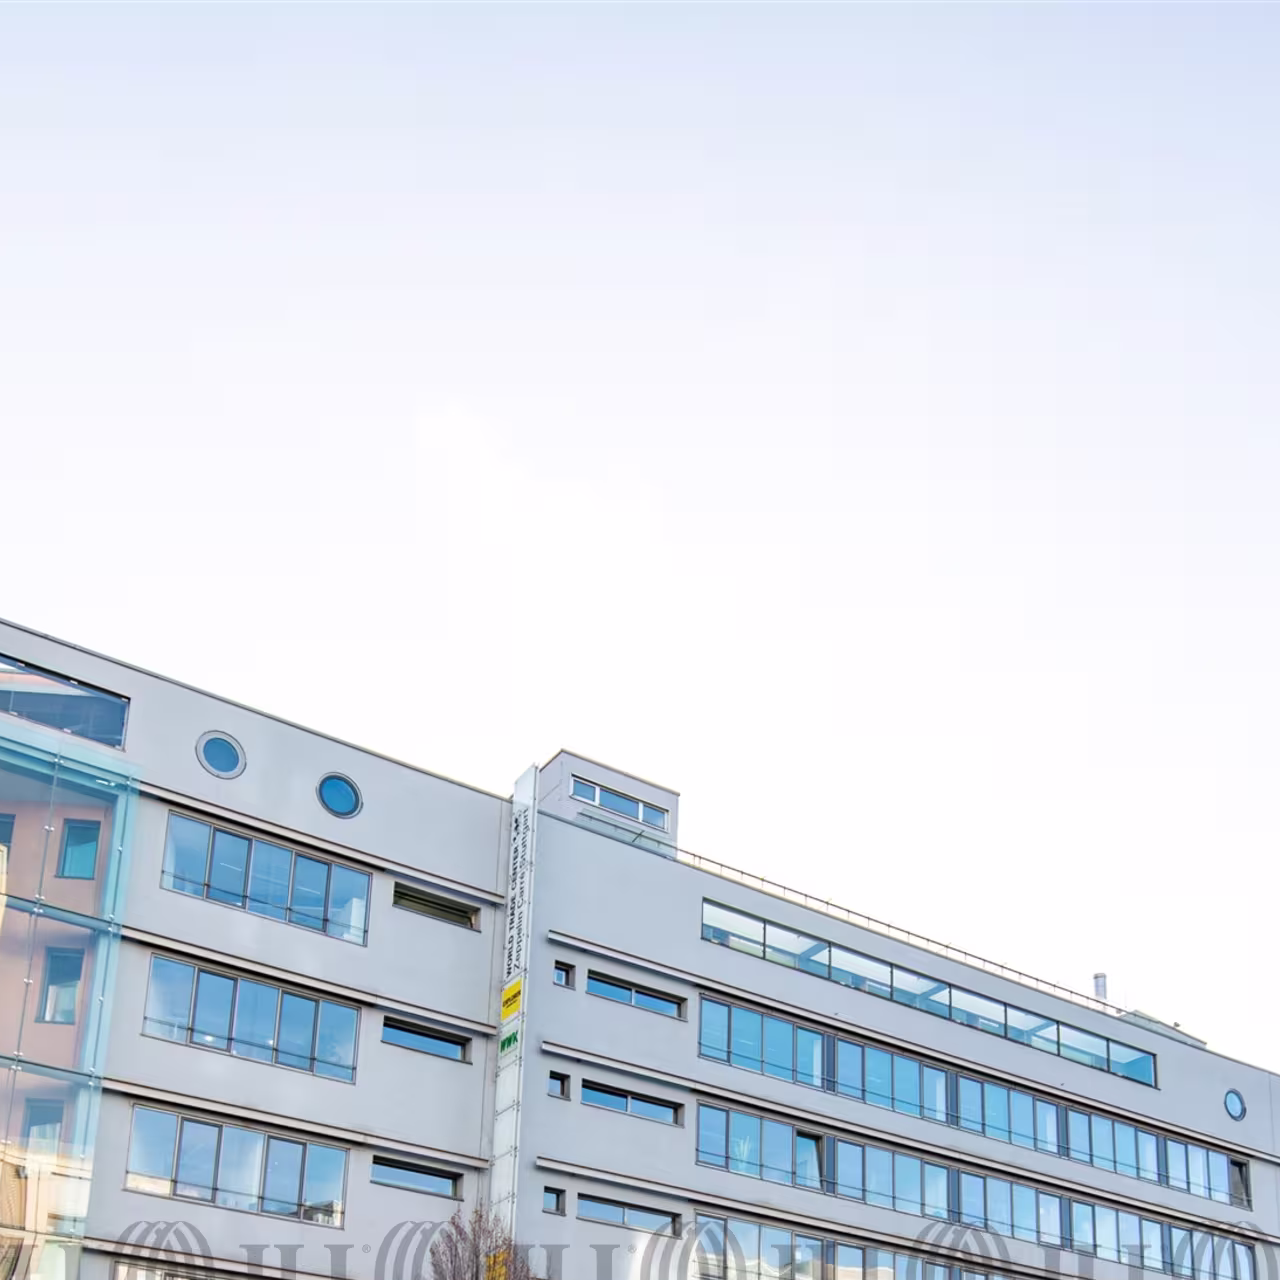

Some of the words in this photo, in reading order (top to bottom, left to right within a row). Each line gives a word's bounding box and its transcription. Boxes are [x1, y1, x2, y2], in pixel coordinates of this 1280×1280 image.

[511, 845, 519, 890] CENTER
[513, 911, 523, 969] Zeppelin
[519, 808, 530, 869] Stuttgart
[509, 894, 517, 932] TRADE
[506, 935, 514, 978] WORLD
[500, 1030, 518, 1053] WWK
